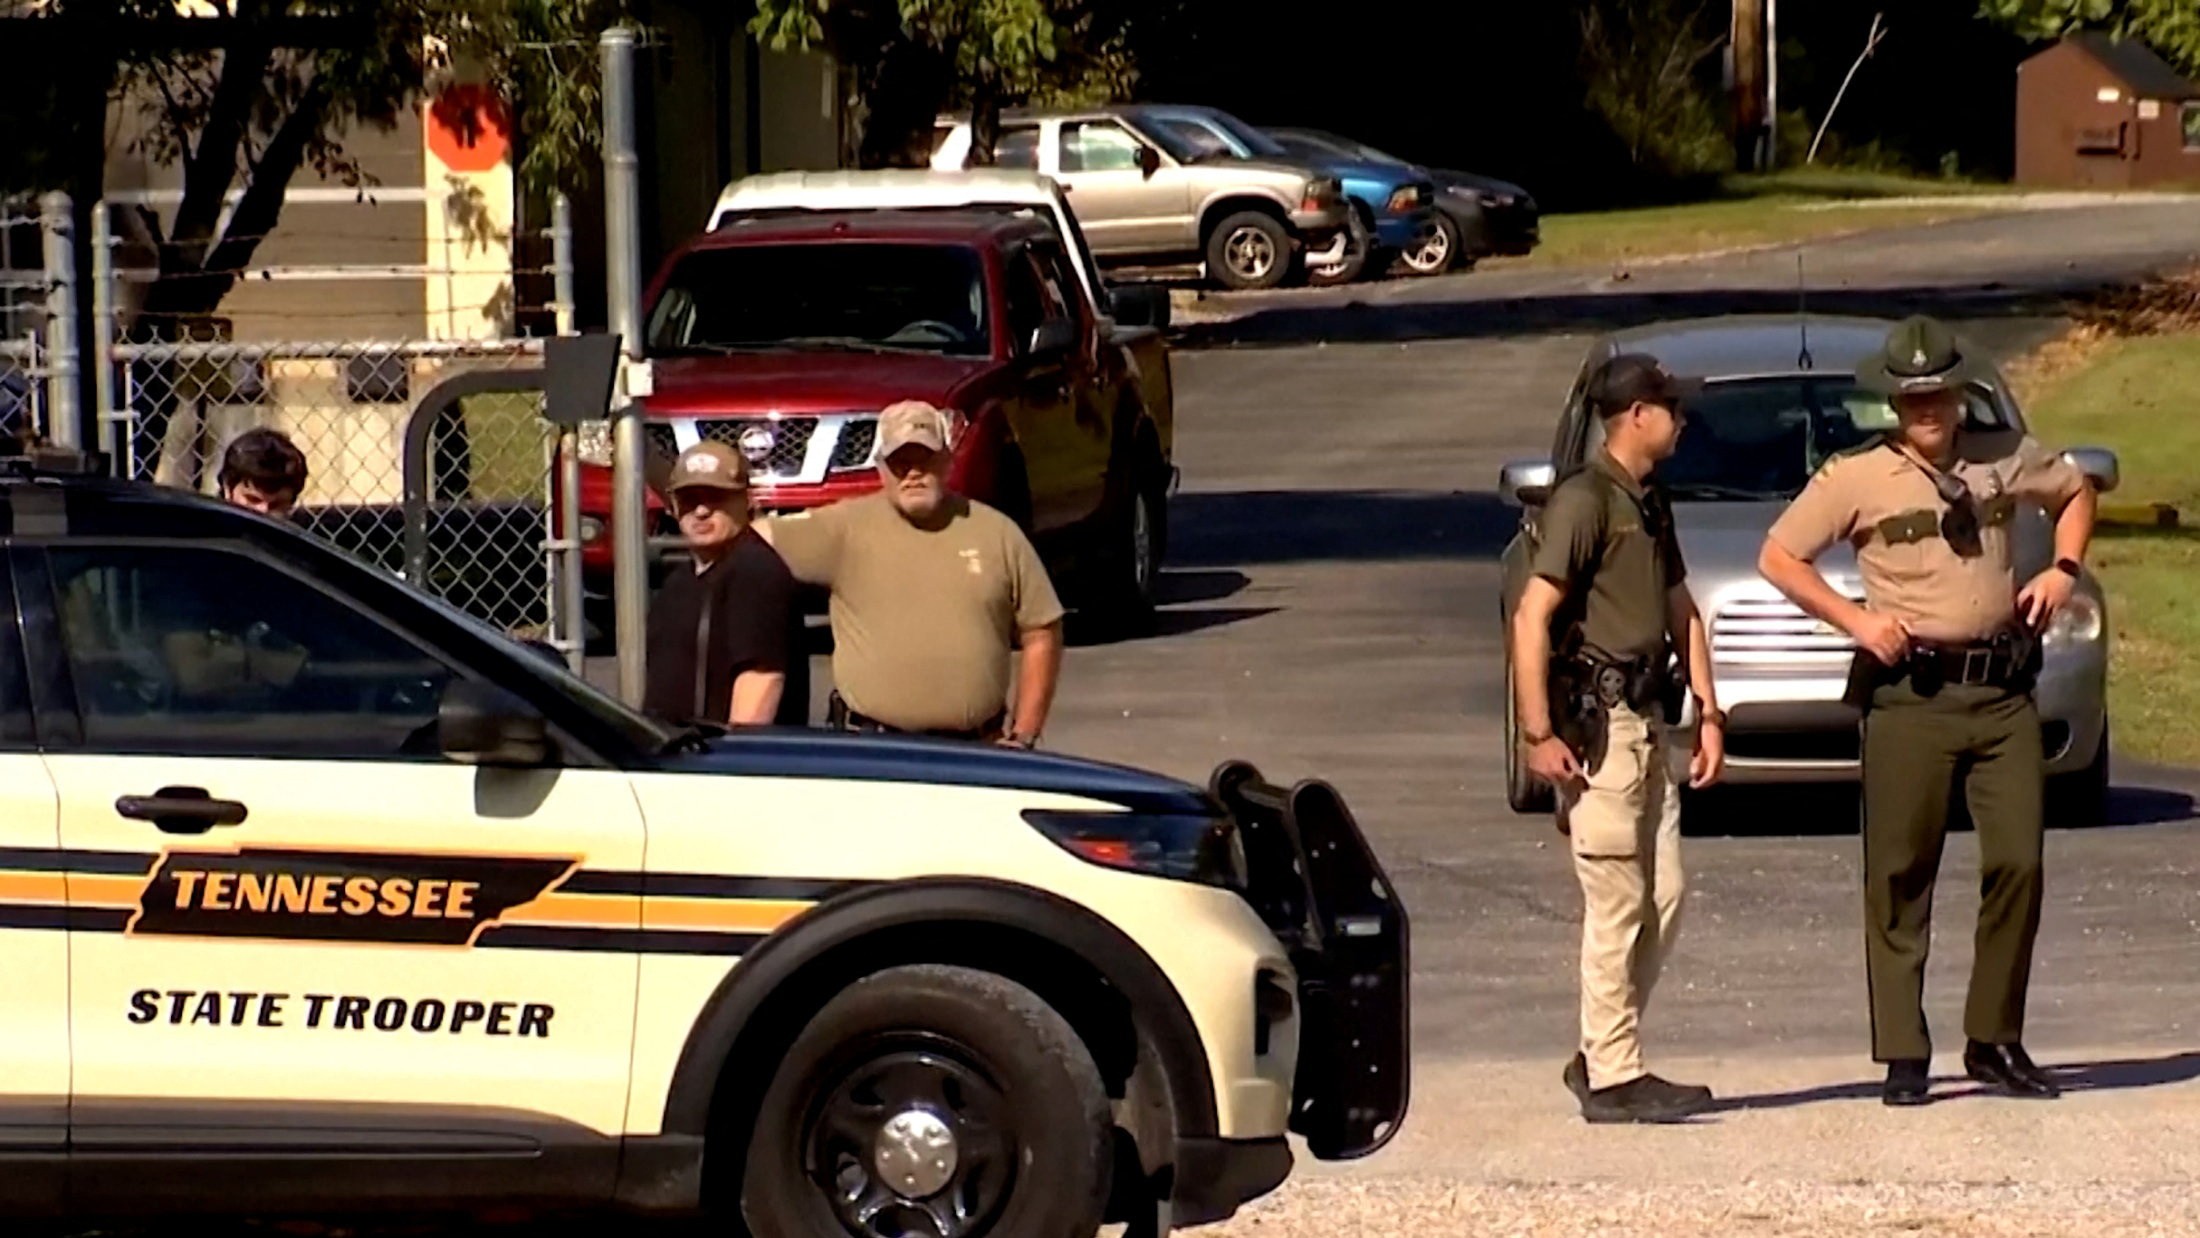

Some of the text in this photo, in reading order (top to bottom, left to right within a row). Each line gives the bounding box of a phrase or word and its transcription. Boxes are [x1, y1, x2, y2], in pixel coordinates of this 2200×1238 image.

[171, 871, 480, 918] TENNESSEE
[127, 989, 555, 1038] STATE TROOPER
